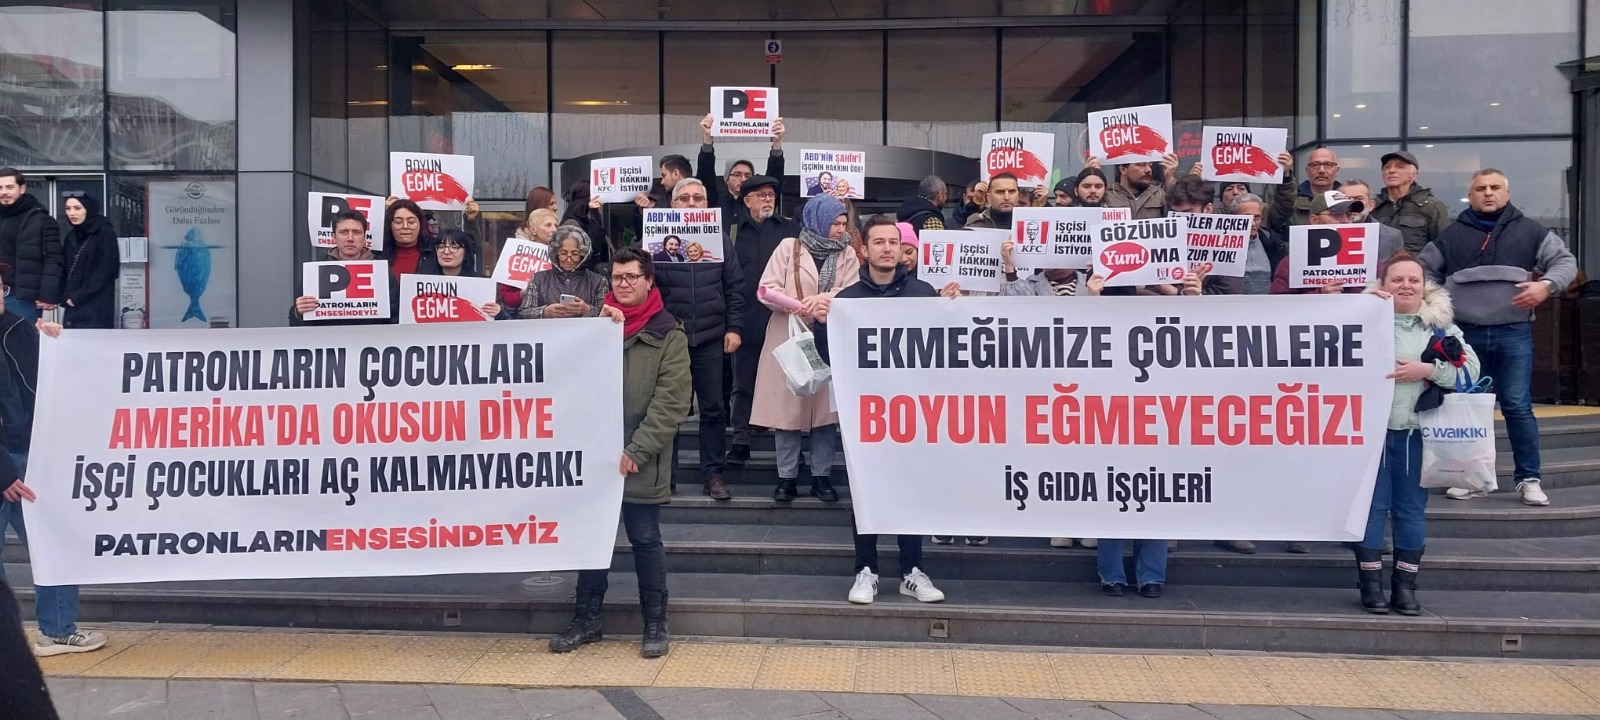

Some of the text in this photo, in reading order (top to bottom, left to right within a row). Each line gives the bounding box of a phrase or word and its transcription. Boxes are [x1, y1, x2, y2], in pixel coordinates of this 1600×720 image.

[723, 89, 767, 119] PE
[1102, 112, 1139, 130] BOYUN
[719, 127, 769, 135] ENSESİNDEYİZ
[1103, 126, 1142, 148] EĞME
[991, 136, 1024, 150] BOYUN
[1216, 132, 1252, 146] BOYUN
[804, 152, 862, 164] ABD'NİN ŞAHİN'İ
[989, 149, 1024, 170] EĞME
[1215, 146, 1252, 165] EĞME
[405, 159, 442, 172] BOYUN
[620, 166, 642, 176] İŞÇİSİ
[802, 162, 864, 173] İŞÇİNİN HAKKINI ÖDE!
[406, 172, 444, 192] EĞME
[620, 184, 649, 192] İSTİYOR
[165, 205, 225, 215] Göründüğünden
[1102, 210, 1127, 220] AHİN'İ
[646, 210, 717, 226] ABD'NİN ŞAHİN'İ
[644, 224, 720, 237] İŞÇİNİN HAKKINI ÖDE!
[1056, 220, 1087, 234] İŞÇİSİ
[1100, 219, 1178, 242] GÖZÜNÜ
[1215, 218, 1250, 234] AÇKEN
[1054, 234, 1092, 244] HAKKIN
[1187, 233, 1244, 248] TRONLARA
[1308, 227, 1366, 266] PE
[516, 244, 549, 262] BOYUN
[960, 244, 989, 256] İŞÇİSİ
[1054, 244, 1092, 256] İSTİYOR
[1103, 248, 1180, 266] Yum! MA
[1187, 248, 1237, 263] ZUR YOK!
[960, 256, 999, 266] HAKKINI
[927, 266, 948, 274] KFC
[958, 266, 996, 278] İSTİYOR
[1302, 268, 1366, 276] PATRONLARIN
[318, 264, 374, 299] PE
[416, 282, 458, 298] BOYUN
[316, 308, 378, 316] ENSESİNDEYİZ
[416, 297, 460, 318] EĞME
[857, 316, 1112, 369] EKMEĞİMİZE
[1128, 316, 1364, 383] ÇÖKENLERE
[122, 342, 545, 401] PATRONLARIN ÇOCUKLARI
[108, 390, 555, 450] AMERİKA'DA OKUSUN DİYE
[858, 382, 1364, 446] BOYUN EĞMEYECEĞİZ!
[1422, 427, 1430, 438] C
[72, 450, 584, 512] İŞÇİ ÇOCUKLARI AÇ KALMAYACAK!
[1004, 465, 1212, 512] İŞ GIDA İŞÇİLERİ
